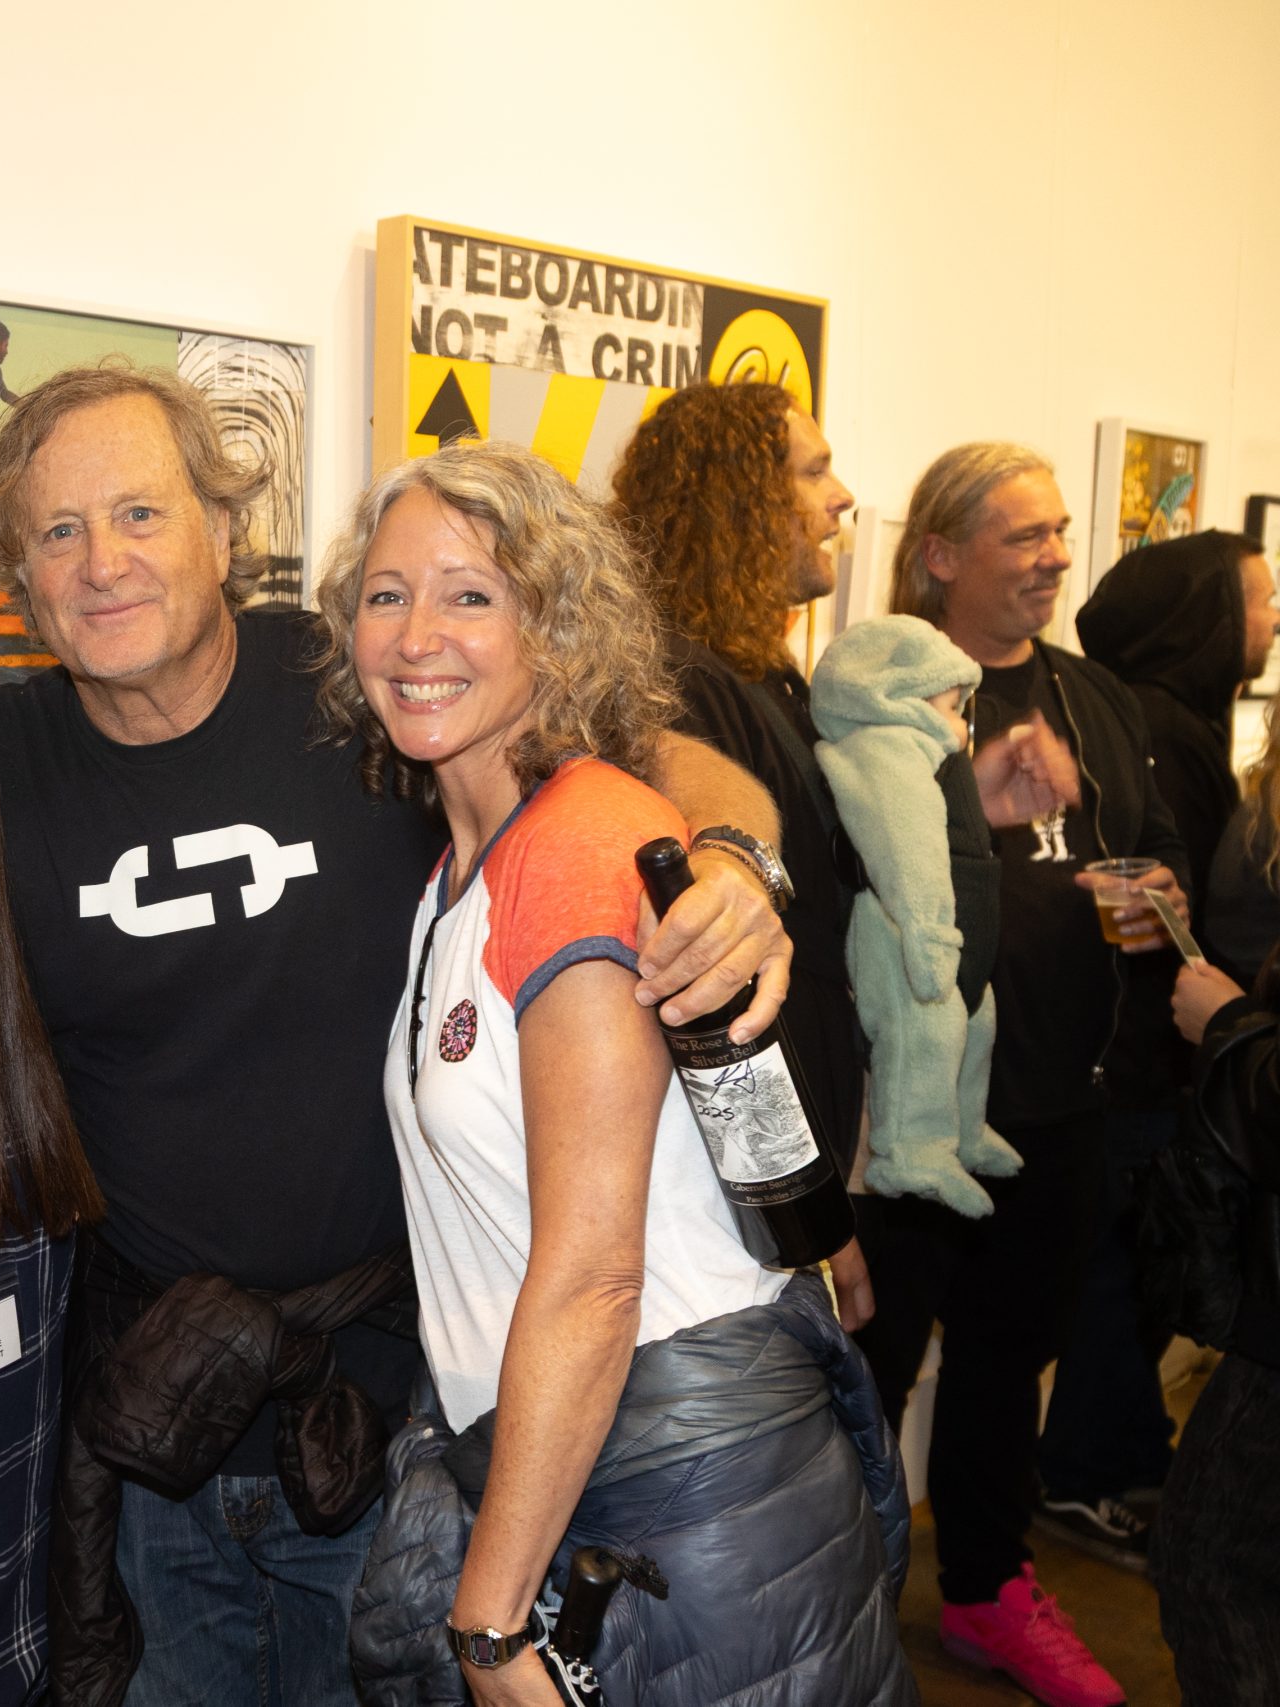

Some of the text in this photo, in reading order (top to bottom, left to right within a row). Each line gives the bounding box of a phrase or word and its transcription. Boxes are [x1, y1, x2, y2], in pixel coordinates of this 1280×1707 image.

[411, 304, 508, 362] NOT
[535, 323, 567, 375] A
[688, 1038, 723, 1052] Rose
[690, 1053, 730, 1067] Silver
[730, 1040, 759, 1061] Bell
[697, 1104, 735, 1121] 2025
[730, 1182, 768, 1192] Cabernet
